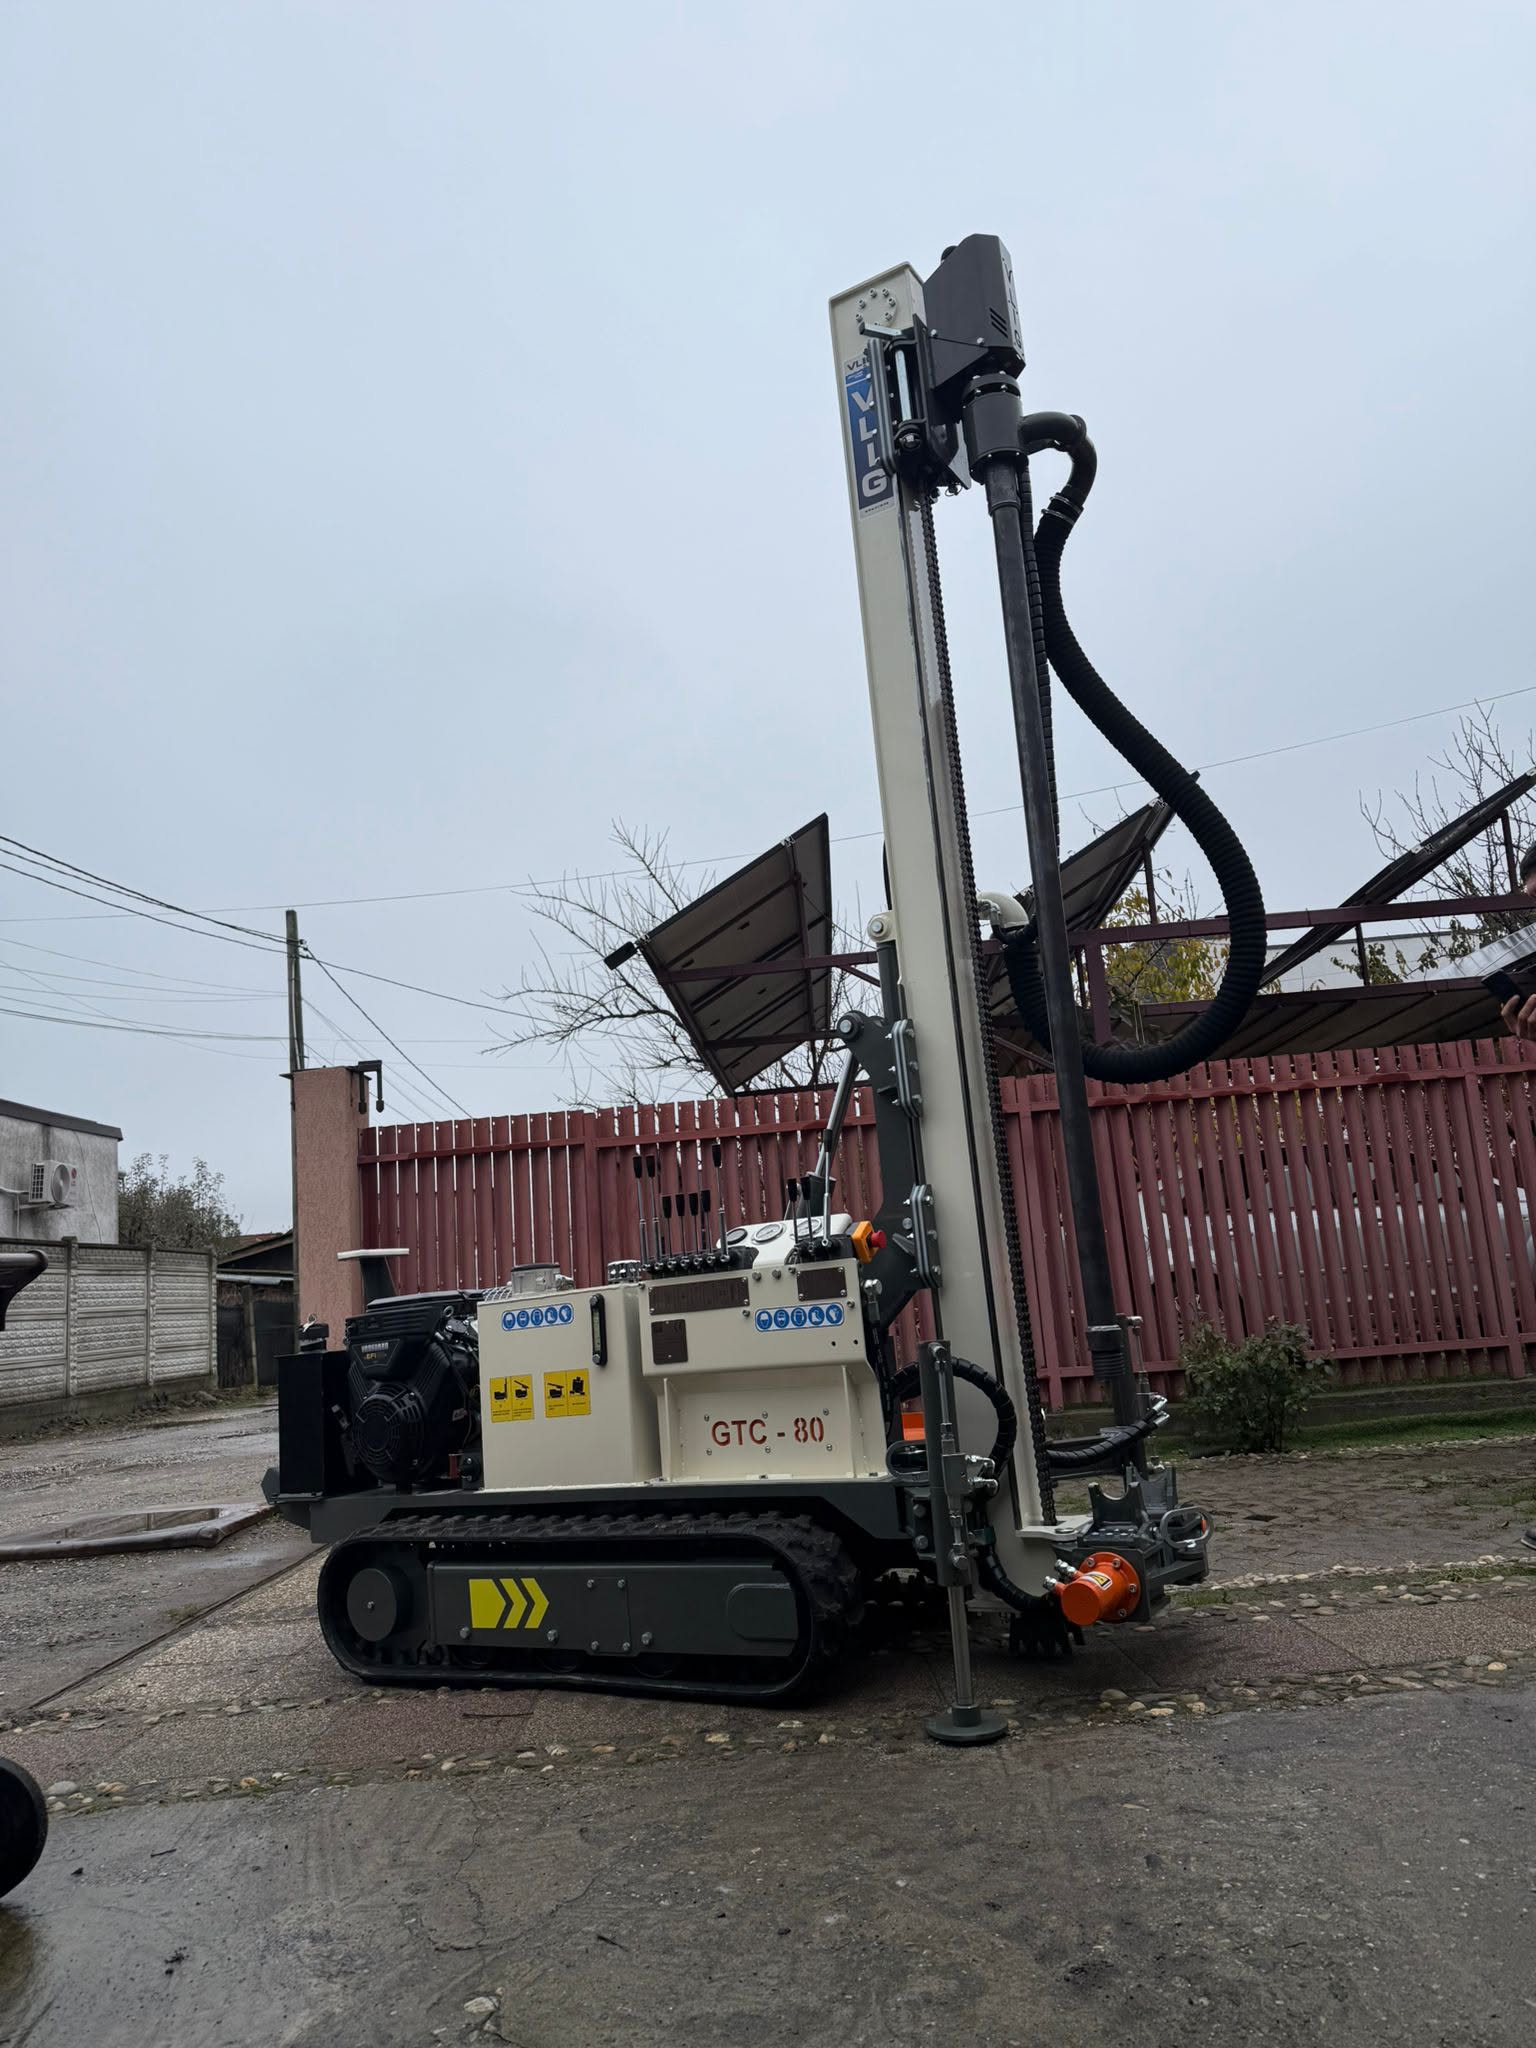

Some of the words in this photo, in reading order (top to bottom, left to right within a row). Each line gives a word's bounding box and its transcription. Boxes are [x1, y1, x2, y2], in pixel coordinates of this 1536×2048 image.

[851, 384, 888, 498] VLIG
[711, 1418, 768, 1447] GTC
[793, 1416, 824, 1443] 80
